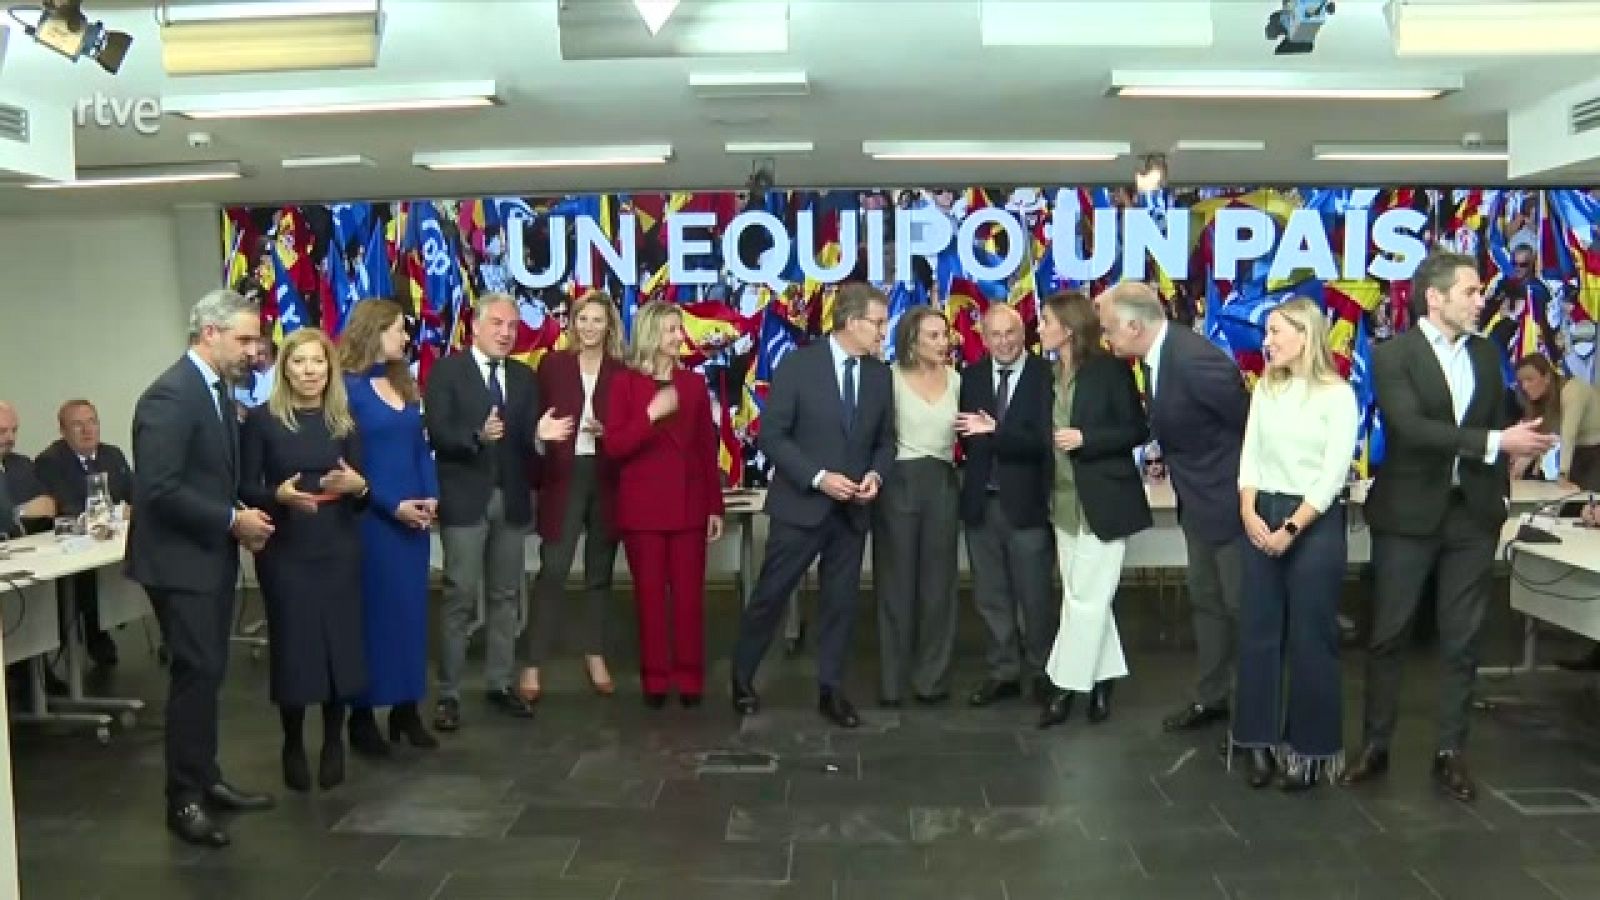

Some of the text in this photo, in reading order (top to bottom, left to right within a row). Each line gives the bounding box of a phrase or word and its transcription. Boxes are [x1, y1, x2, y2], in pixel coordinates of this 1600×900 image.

[507, 213, 637, 289] UN
[669, 209, 1024, 288] EQUIPO
[1052, 208, 1190, 281] UN
[1214, 189, 1428, 281] PAÍS
